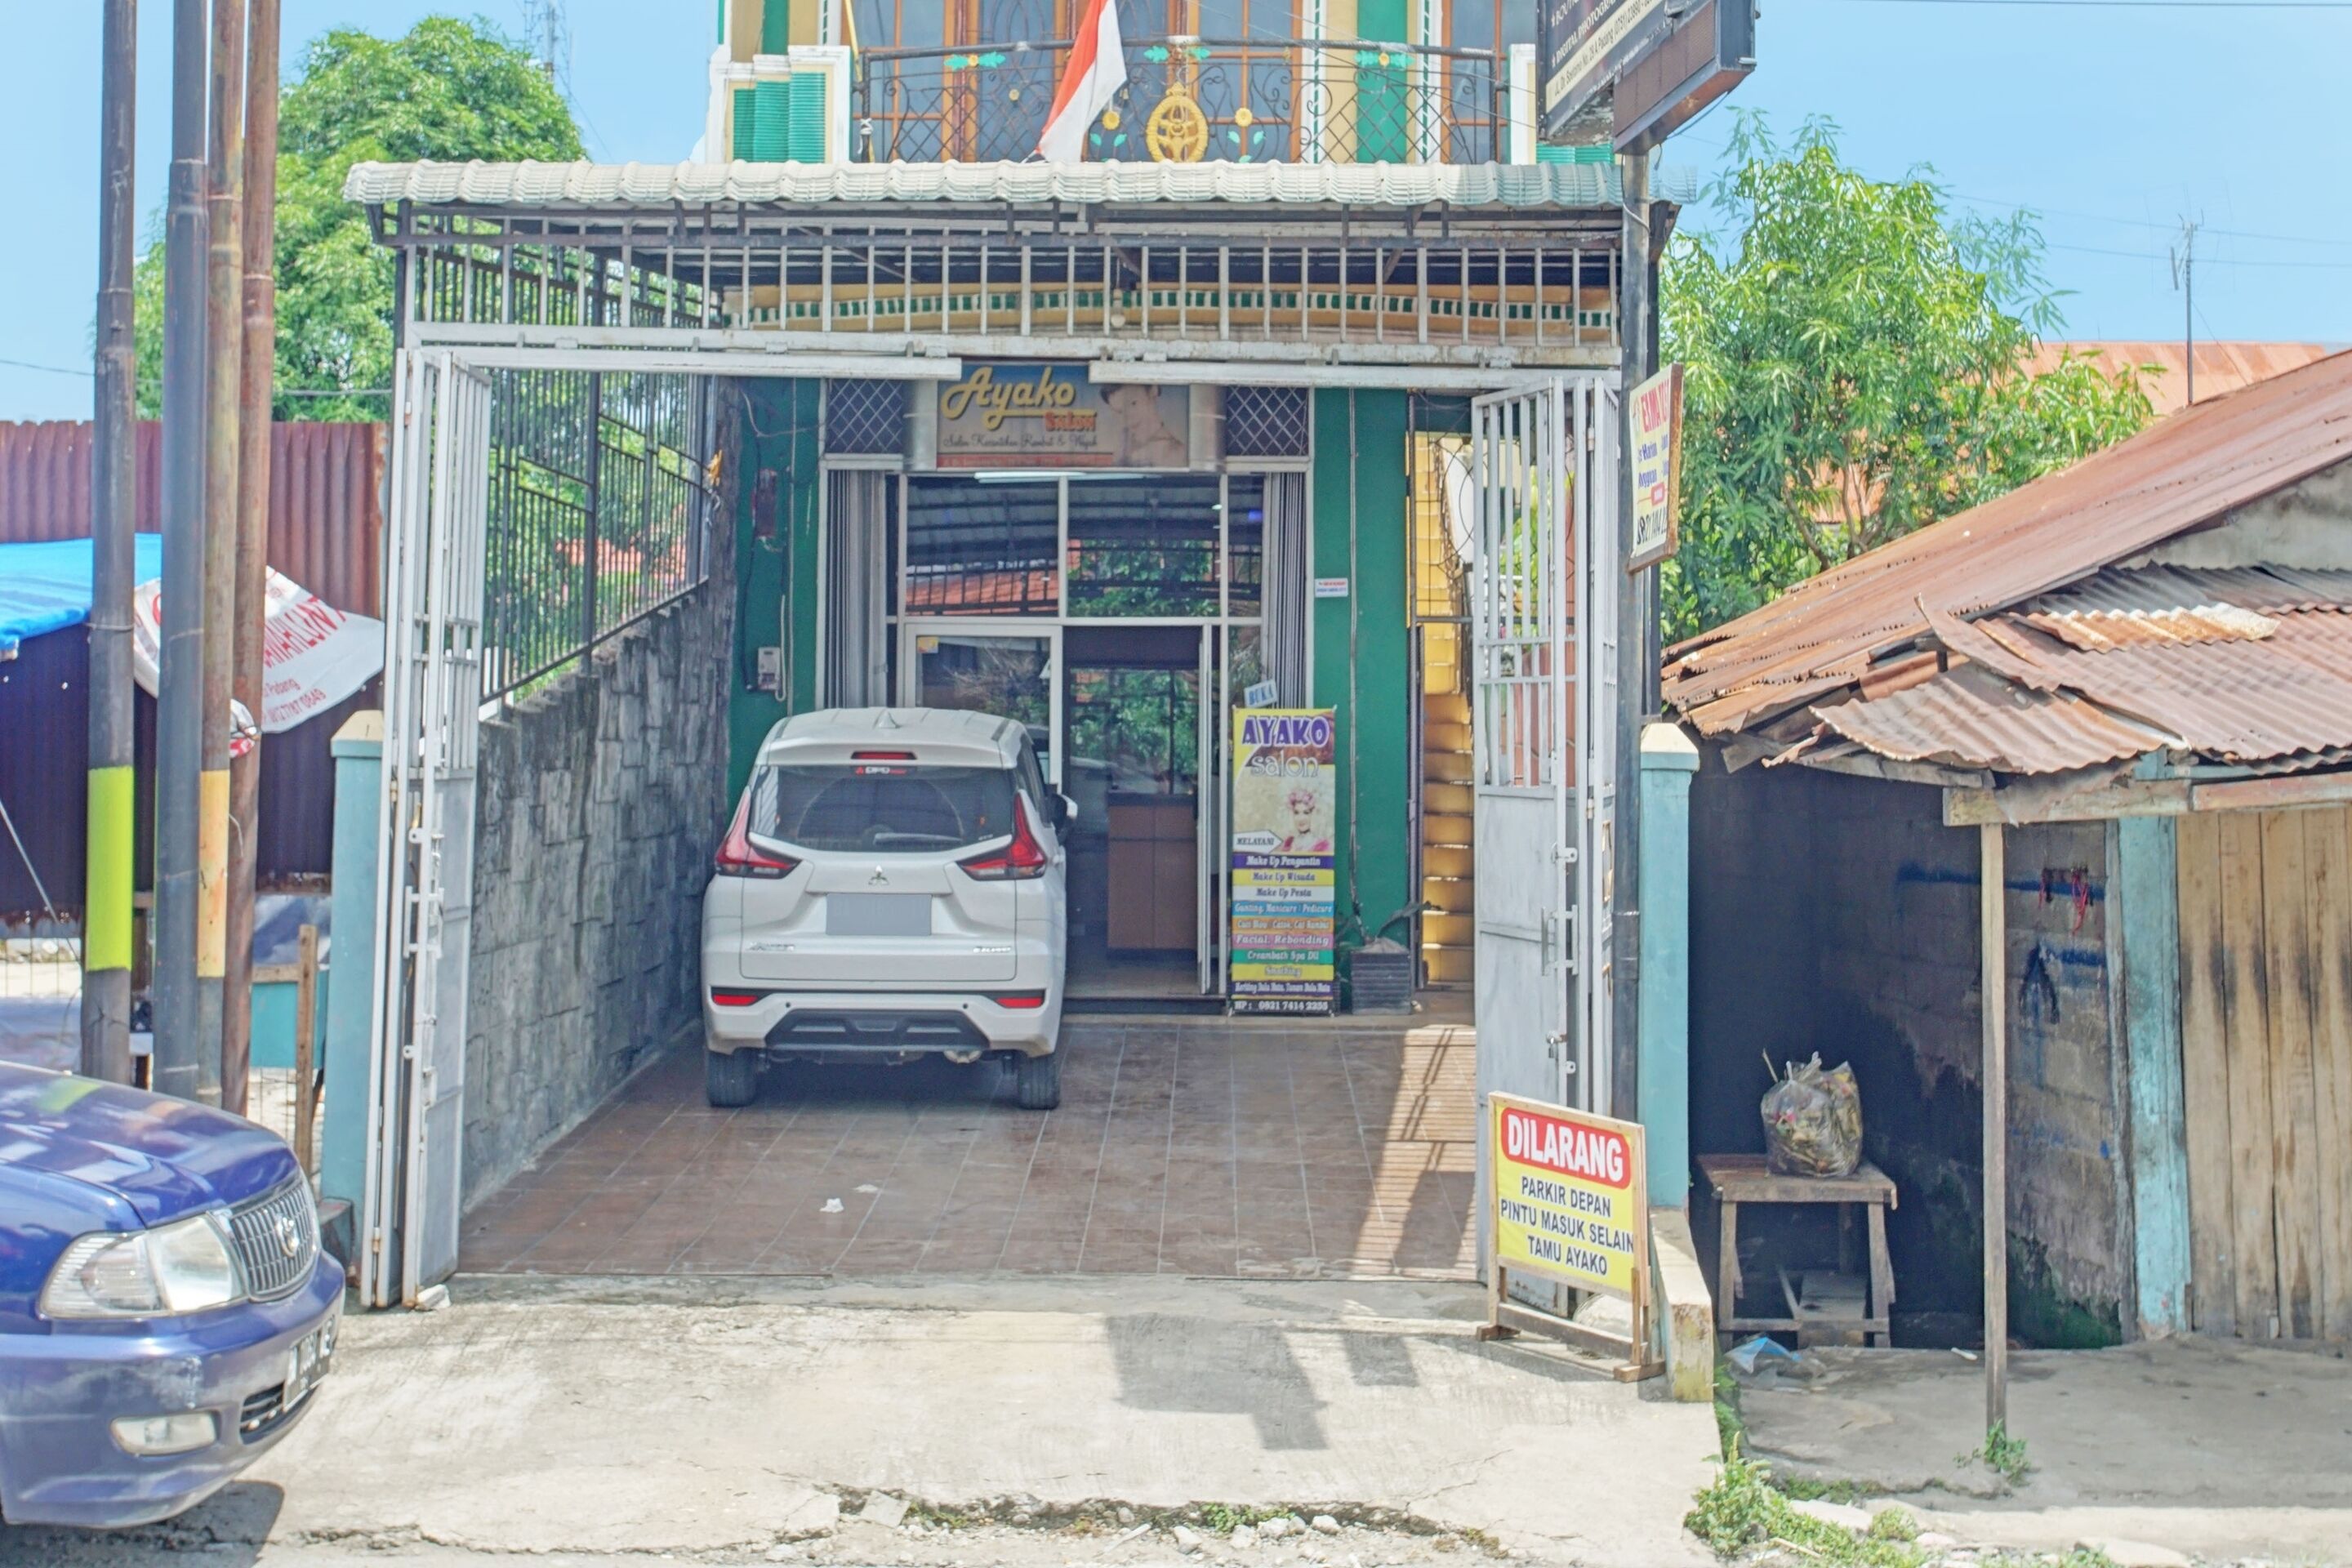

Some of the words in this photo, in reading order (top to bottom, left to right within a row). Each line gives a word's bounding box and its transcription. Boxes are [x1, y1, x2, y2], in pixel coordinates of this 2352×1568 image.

[940, 367, 1086, 431] Ayako
[1241, 715, 1330, 747] AYAKO
[1251, 751, 1319, 777] salon
[1246, 856, 1267, 866] Make
[1269, 856, 1279, 867] Up
[1281, 856, 1321, 867] Pengantin
[1253, 872, 1272, 881] Make
[1276, 872, 1285, 883] Up
[1288, 873, 1316, 881] Wisuda
[1256, 888, 1276, 897] Make
[1278, 888, 1289, 899] Up
[1290, 888, 1312, 897] Pesta
[1274, 935, 1330, 947] Rebonding
[1247, 951, 1289, 960] Creambath
[1290, 951, 1306, 962] Spa
[1508, 1114, 1624, 1183] DILARANG
[1521, 1176, 1566, 1203] PARKIR
[1570, 1187, 1611, 1218] DEPAN
[1500, 1199, 1537, 1225] PINTU
[1541, 1208, 1585, 1240] MASUK
[1589, 1224, 1634, 1253] SELAIN
[1527, 1236, 1561, 1263] TAMU
[1566, 1246, 1608, 1276] AYAKO
